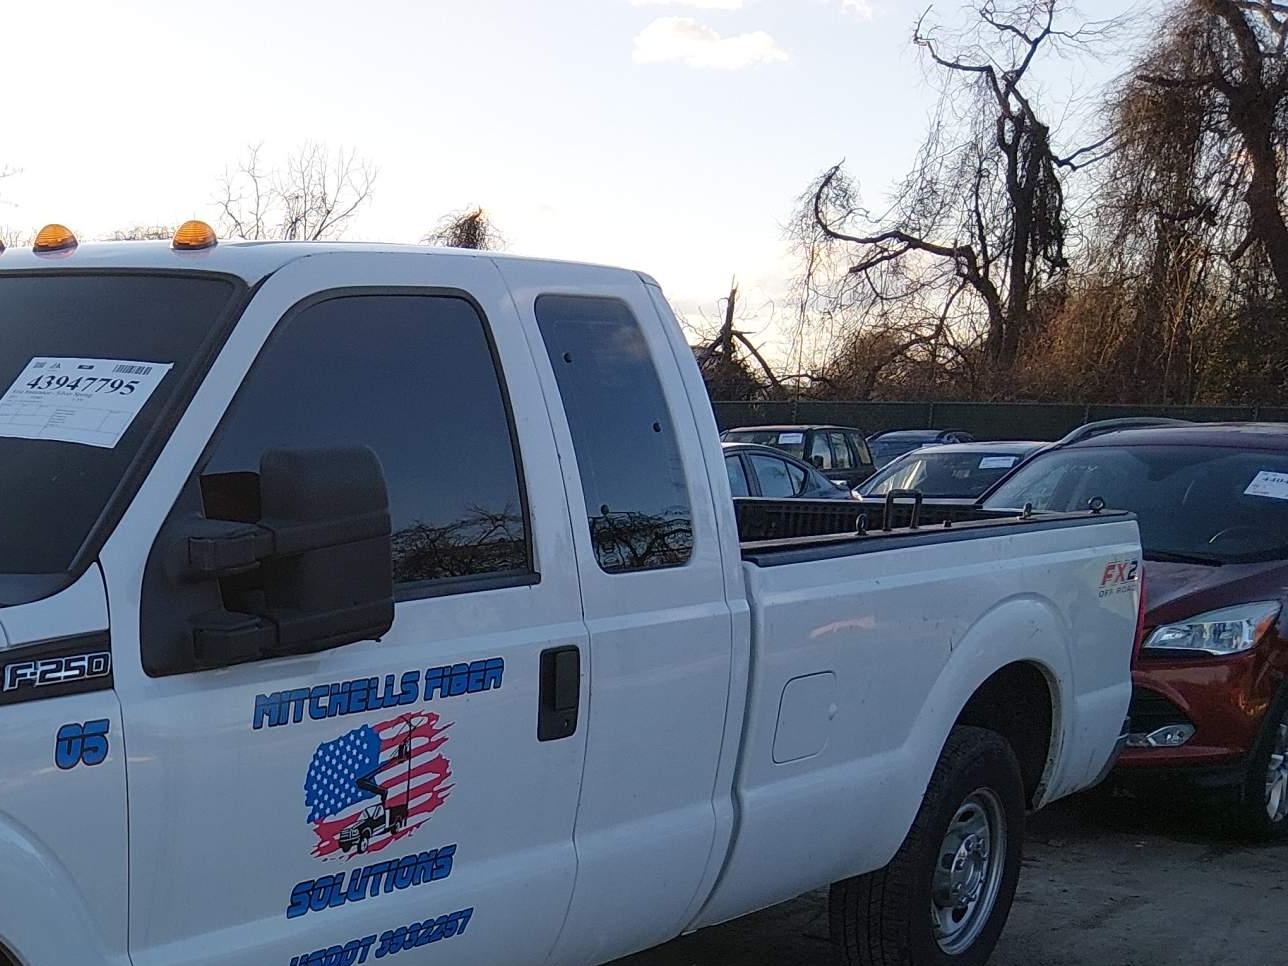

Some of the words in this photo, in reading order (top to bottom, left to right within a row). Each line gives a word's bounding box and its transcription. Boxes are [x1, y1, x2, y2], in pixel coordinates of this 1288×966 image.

[27, 375, 140, 395] 43947795
[1101, 560, 1138, 586] FX2
[3, 652, 111, 692] F-250
[253, 671, 420, 729] MITCHELLS
[424, 657, 505, 701] FIBER
[55, 718, 110, 769] 05
[287, 844, 457, 919] SOLUTIONS
